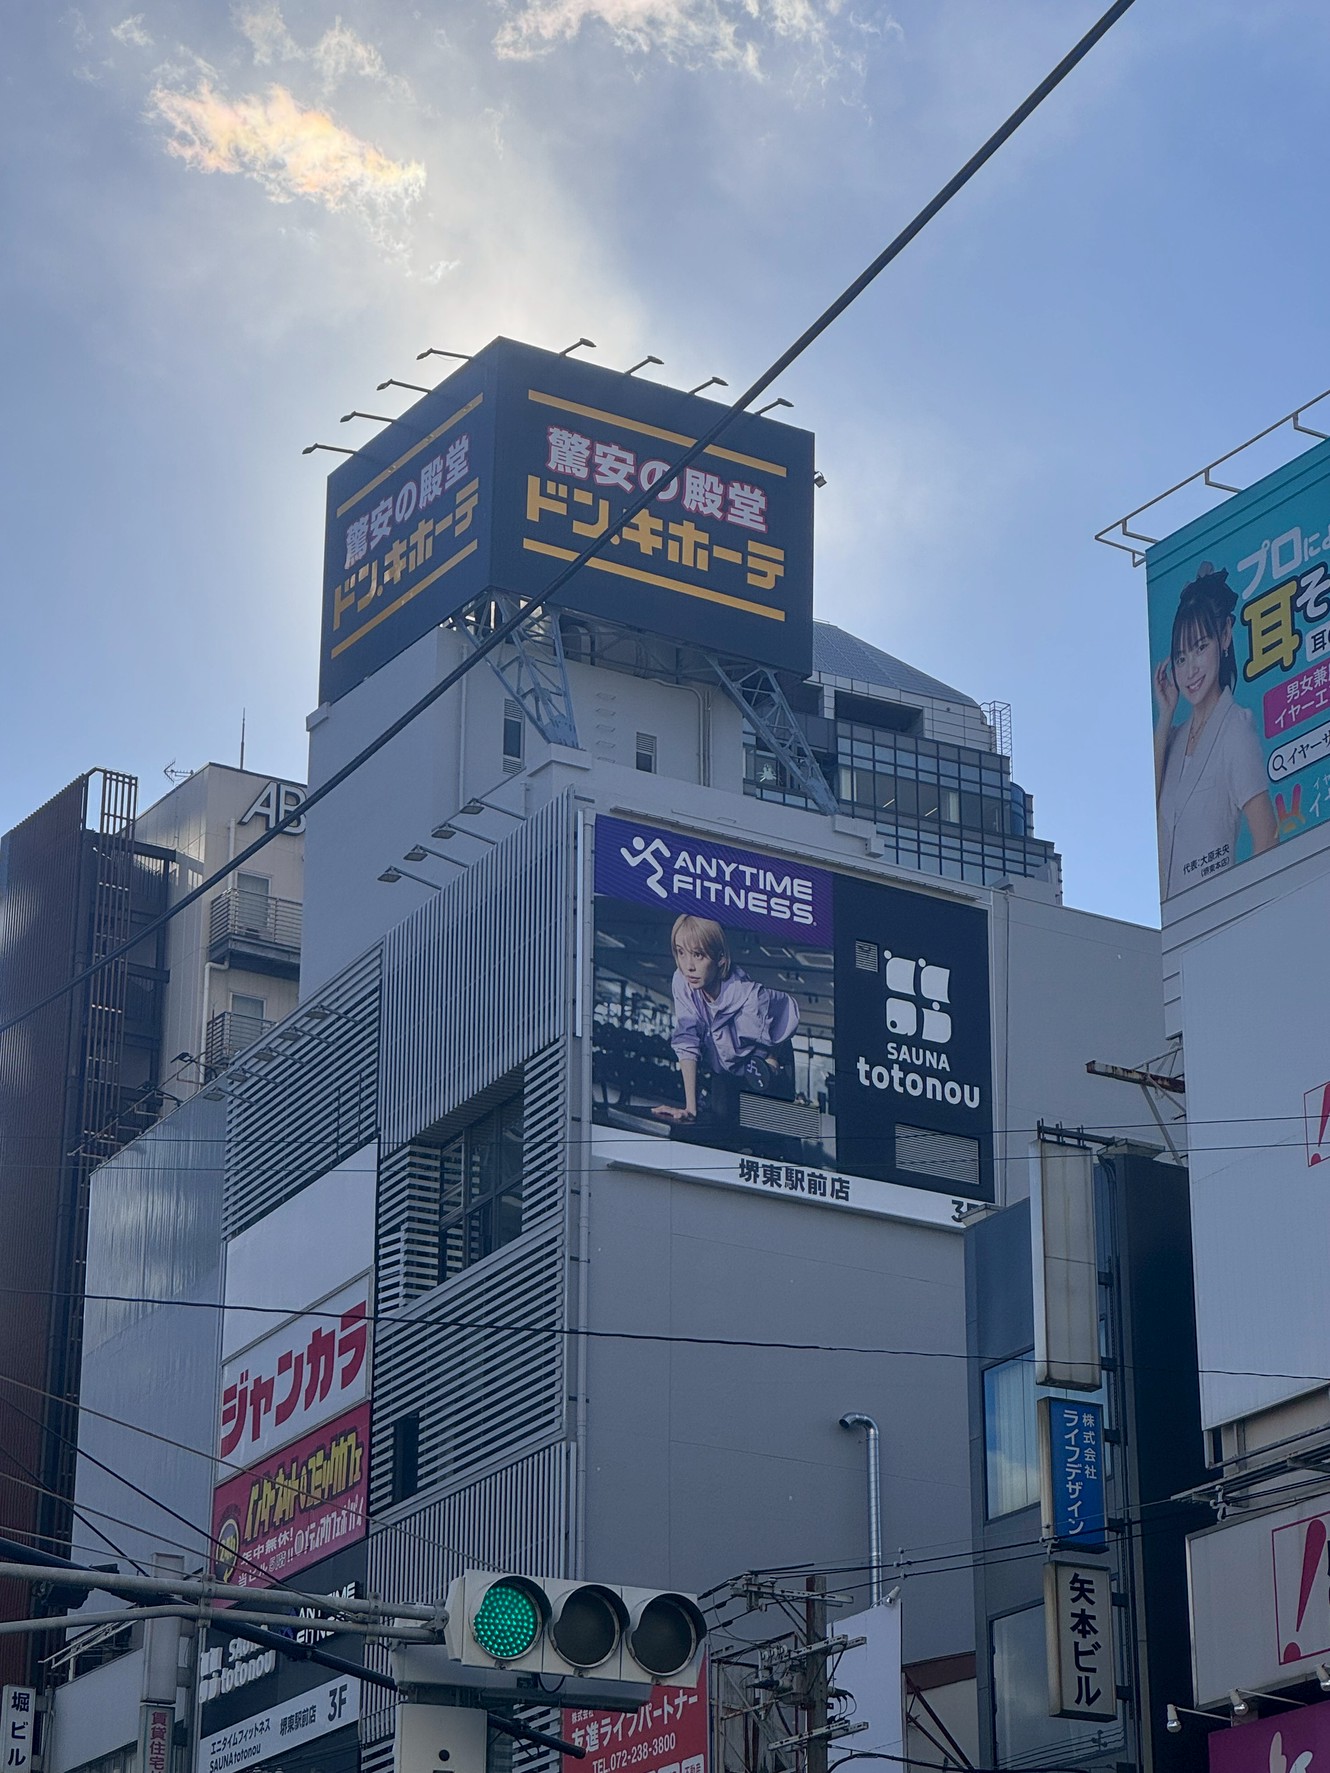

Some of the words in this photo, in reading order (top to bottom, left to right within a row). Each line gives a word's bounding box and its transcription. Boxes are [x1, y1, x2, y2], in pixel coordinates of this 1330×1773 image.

[343, 433, 471, 570] 驚安の殿堂
[546, 424, 768, 533] 驚安の殿堂
[1286, 662, 1330, 704] 男女兼
[673, 851, 813, 901] ANYTIME
[673, 874, 814, 925] FITNESS
[857, 1056, 980, 1108] totonou
[887, 1042, 951, 1072] SAUNA
[738, 1158, 851, 1202] 堺東駅前店
[220, 1299, 367, 1459] ジャンカラ
[1063, 1409, 1084, 1535] ライフデザイン
[1082, 1412, 1097, 1479] 株式会社
[1069, 1572, 1102, 1707] 矢本ビル
[221, 1650, 277, 1694] totonou
[7, 1691, 31, 1767] 堀ビル
[280, 1704, 317, 1737] 堺東駅前店
[327, 1683, 349, 1722] 3F
[149, 1710, 168, 1773] 賃貸住宅
